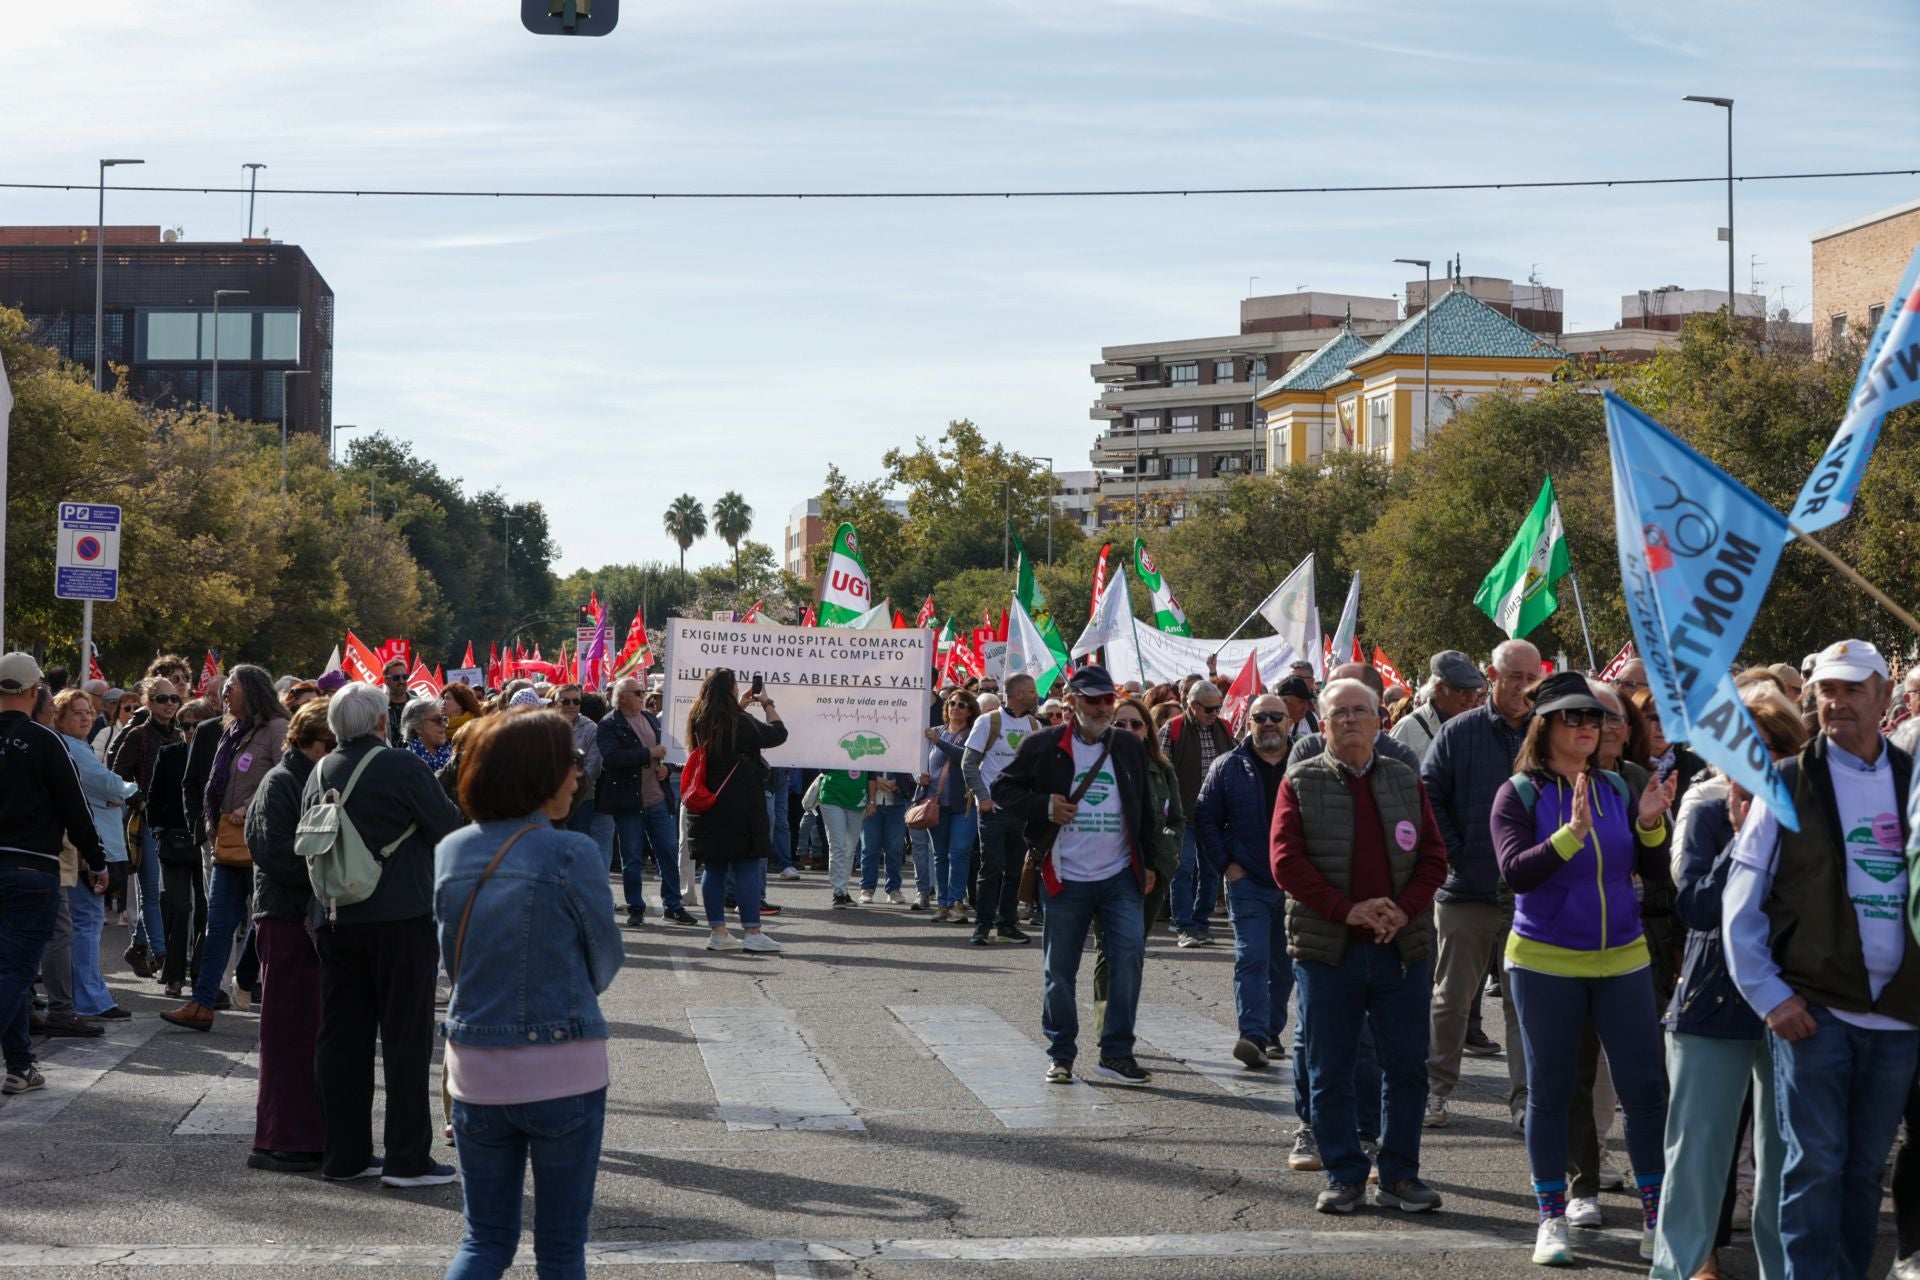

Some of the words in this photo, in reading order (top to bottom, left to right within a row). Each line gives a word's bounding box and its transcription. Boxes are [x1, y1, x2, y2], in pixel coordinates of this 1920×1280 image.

[64, 505, 76, 520] P
[1165, 625, 1184, 633] And.
[682, 628, 747, 643] EXIGIMOS
[753, 634, 772, 644] UN
[778, 634, 844, 647] HOSPITAL
[850, 637, 924, 649] COMARCAL
[700, 643, 727, 655] QUE
[733, 645, 803, 658] FUNCIONE
[809, 648, 825, 658] AL
[830, 649, 904, 661] COMPLETO
[799, 672, 882, 687] ABIERTAS
[890, 675, 924, 688] YA!!
[816, 696, 832, 704] nos
[834, 697, 844, 705] va
[846, 696, 855, 705] la
[857, 696, 876, 706] vida
[878, 698, 889, 706] en
[891, 697, 908, 707] ello
